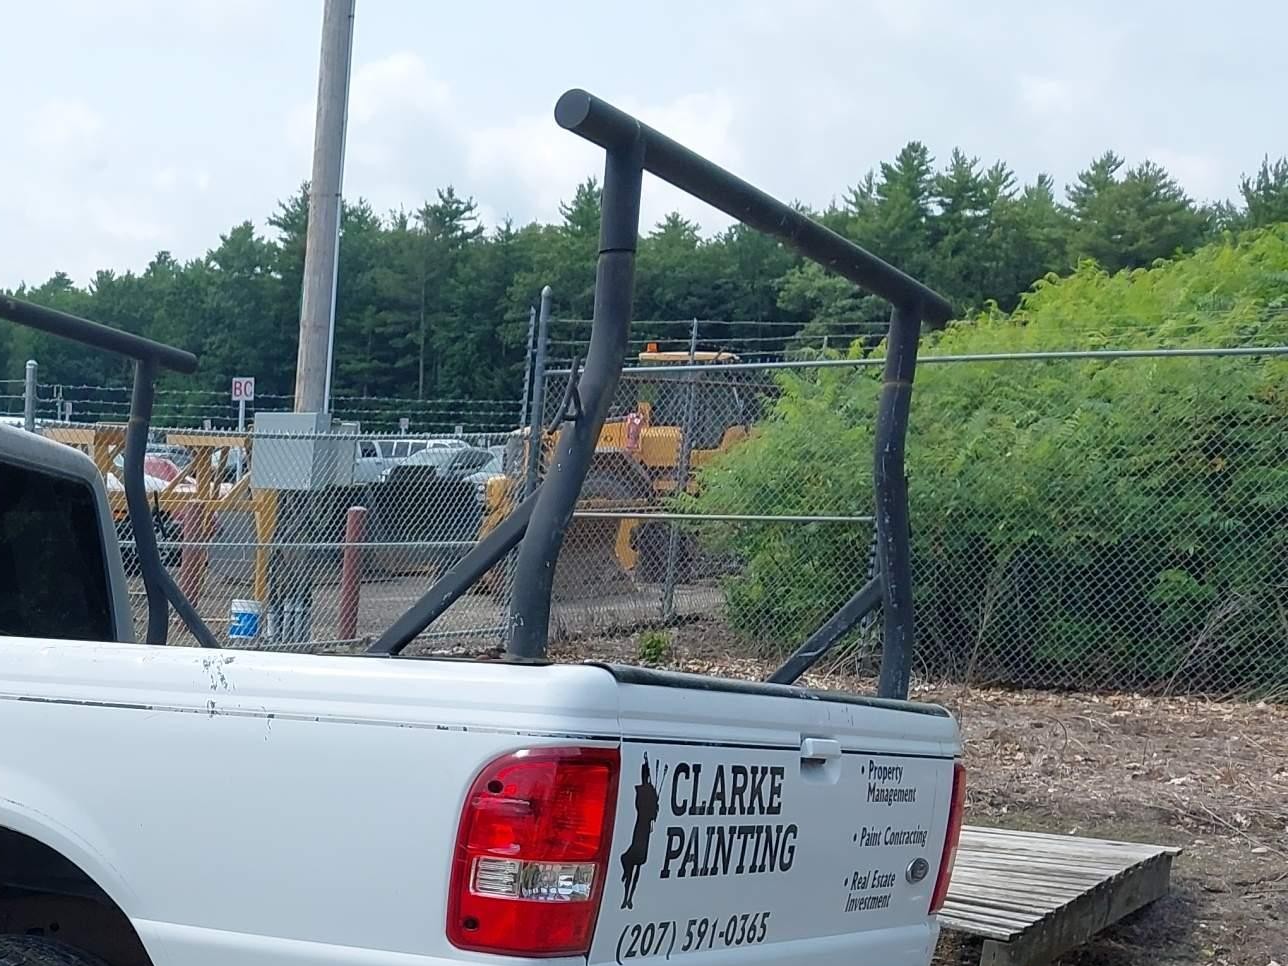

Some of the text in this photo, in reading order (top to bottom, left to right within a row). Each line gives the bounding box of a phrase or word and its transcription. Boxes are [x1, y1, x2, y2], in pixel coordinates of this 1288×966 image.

[233, 380, 253, 398] BC
[868, 759, 904, 784] Property
[670, 762, 785, 817] CLARKE
[866, 782, 917, 807] Management
[859, 825, 928, 848] Paint Contracting
[659, 824, 798, 879] PAINTING
[850, 870, 871, 891] Real
[871, 869, 896, 889] Estate
[844, 892, 892, 913] Investment
[615, 912, 771, 966] (207) 591-0365
